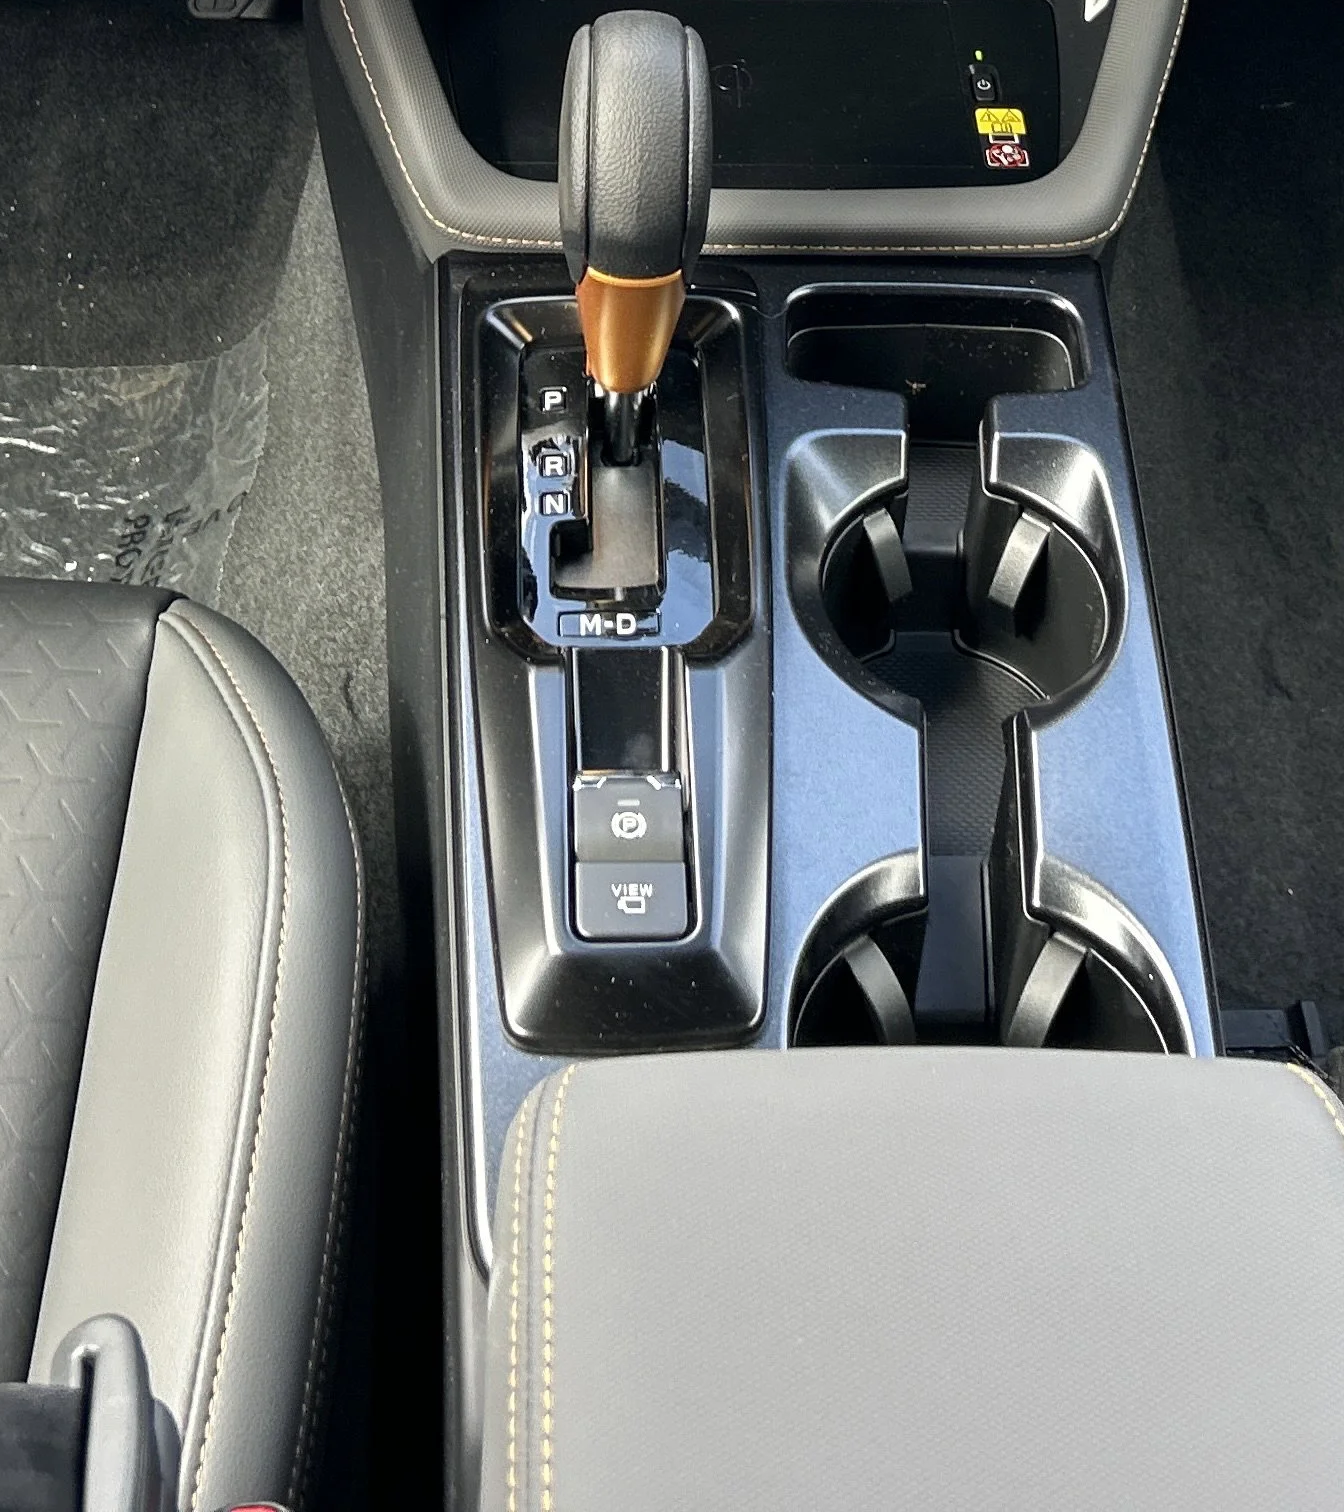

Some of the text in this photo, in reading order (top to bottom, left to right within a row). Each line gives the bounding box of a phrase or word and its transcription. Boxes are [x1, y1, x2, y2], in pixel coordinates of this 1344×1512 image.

[544, 391, 563, 409] P
[545, 457, 564, 476] R
[546, 496, 564, 514] N
[579, 613, 637, 637] M-D
[611, 883, 654, 897] VIEW
